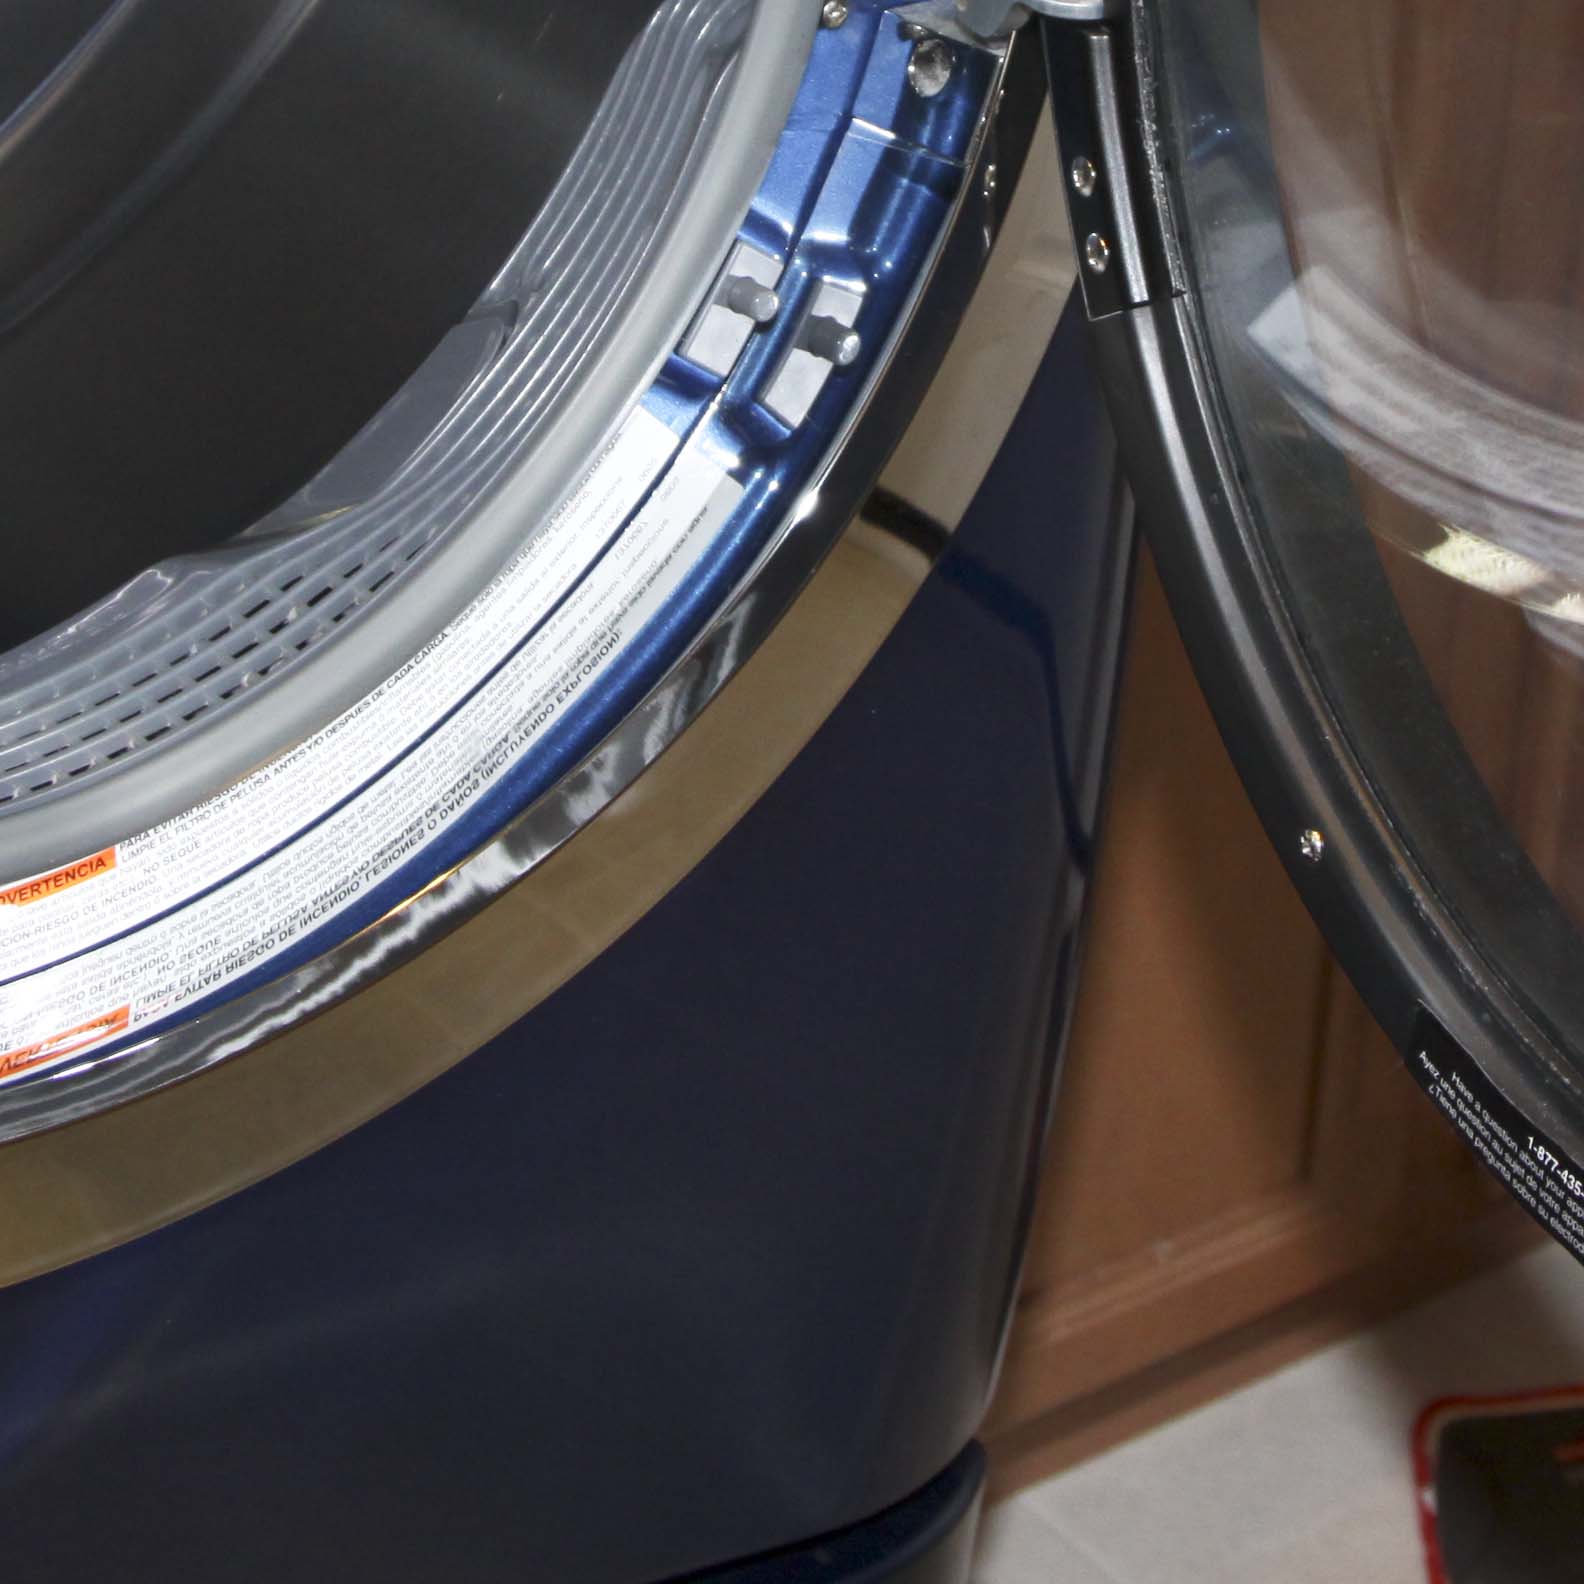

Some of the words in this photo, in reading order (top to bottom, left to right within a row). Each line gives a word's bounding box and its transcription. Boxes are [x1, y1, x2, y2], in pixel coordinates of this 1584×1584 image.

[1419, 1049, 1440, 1080] Ayez
[1440, 1077, 1456, 1100] une
[1456, 1097, 1492, 1142] question
[1491, 1138, 1504, 1156] au
[1525, 1174, 1538, 1192] de
[1538, 1188, 1562, 1215] votre
[1451, 1071, 1474, 1104] Have
[1475, 1101, 1482, 1114] a
[1482, 1109, 1518, 1153] question
[1519, 1149, 1545, 1181] about
[1544, 1176, 1566, 1200] your
[1457, 1116, 1474, 1140] una
[1474, 1136, 1512, 1183] pregunta
[1511, 1177, 1537, 1209] sobre
[1537, 1203, 1550, 1221] su
